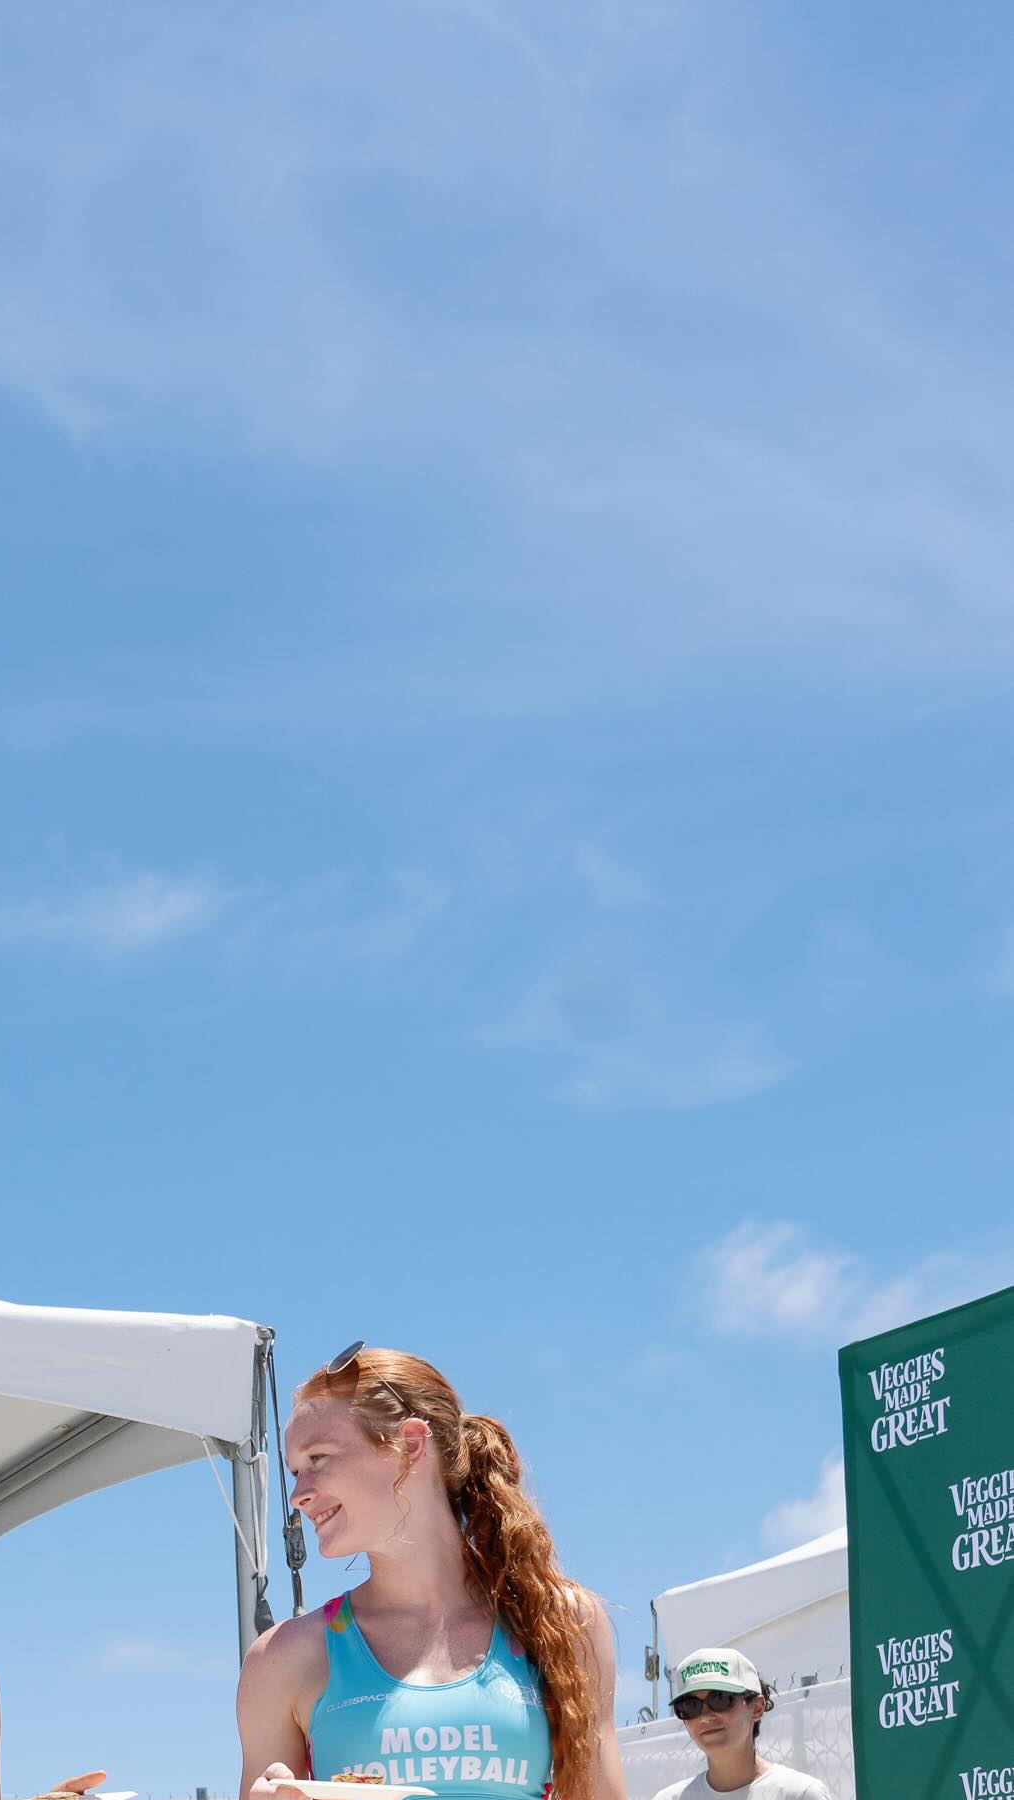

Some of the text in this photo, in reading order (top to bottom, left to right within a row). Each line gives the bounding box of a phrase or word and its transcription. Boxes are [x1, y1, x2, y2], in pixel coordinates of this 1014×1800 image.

[868, 1347, 945, 1400] VEGGIES
[883, 1379, 931, 1413] MADE
[871, 1396, 951, 1452] GREAT
[876, 1629, 953, 1675] VEGGIES
[891, 1659, 939, 1689] MADE
[879, 1680, 959, 1729] GREAT
[380, 1725, 498, 1755] MODEL
